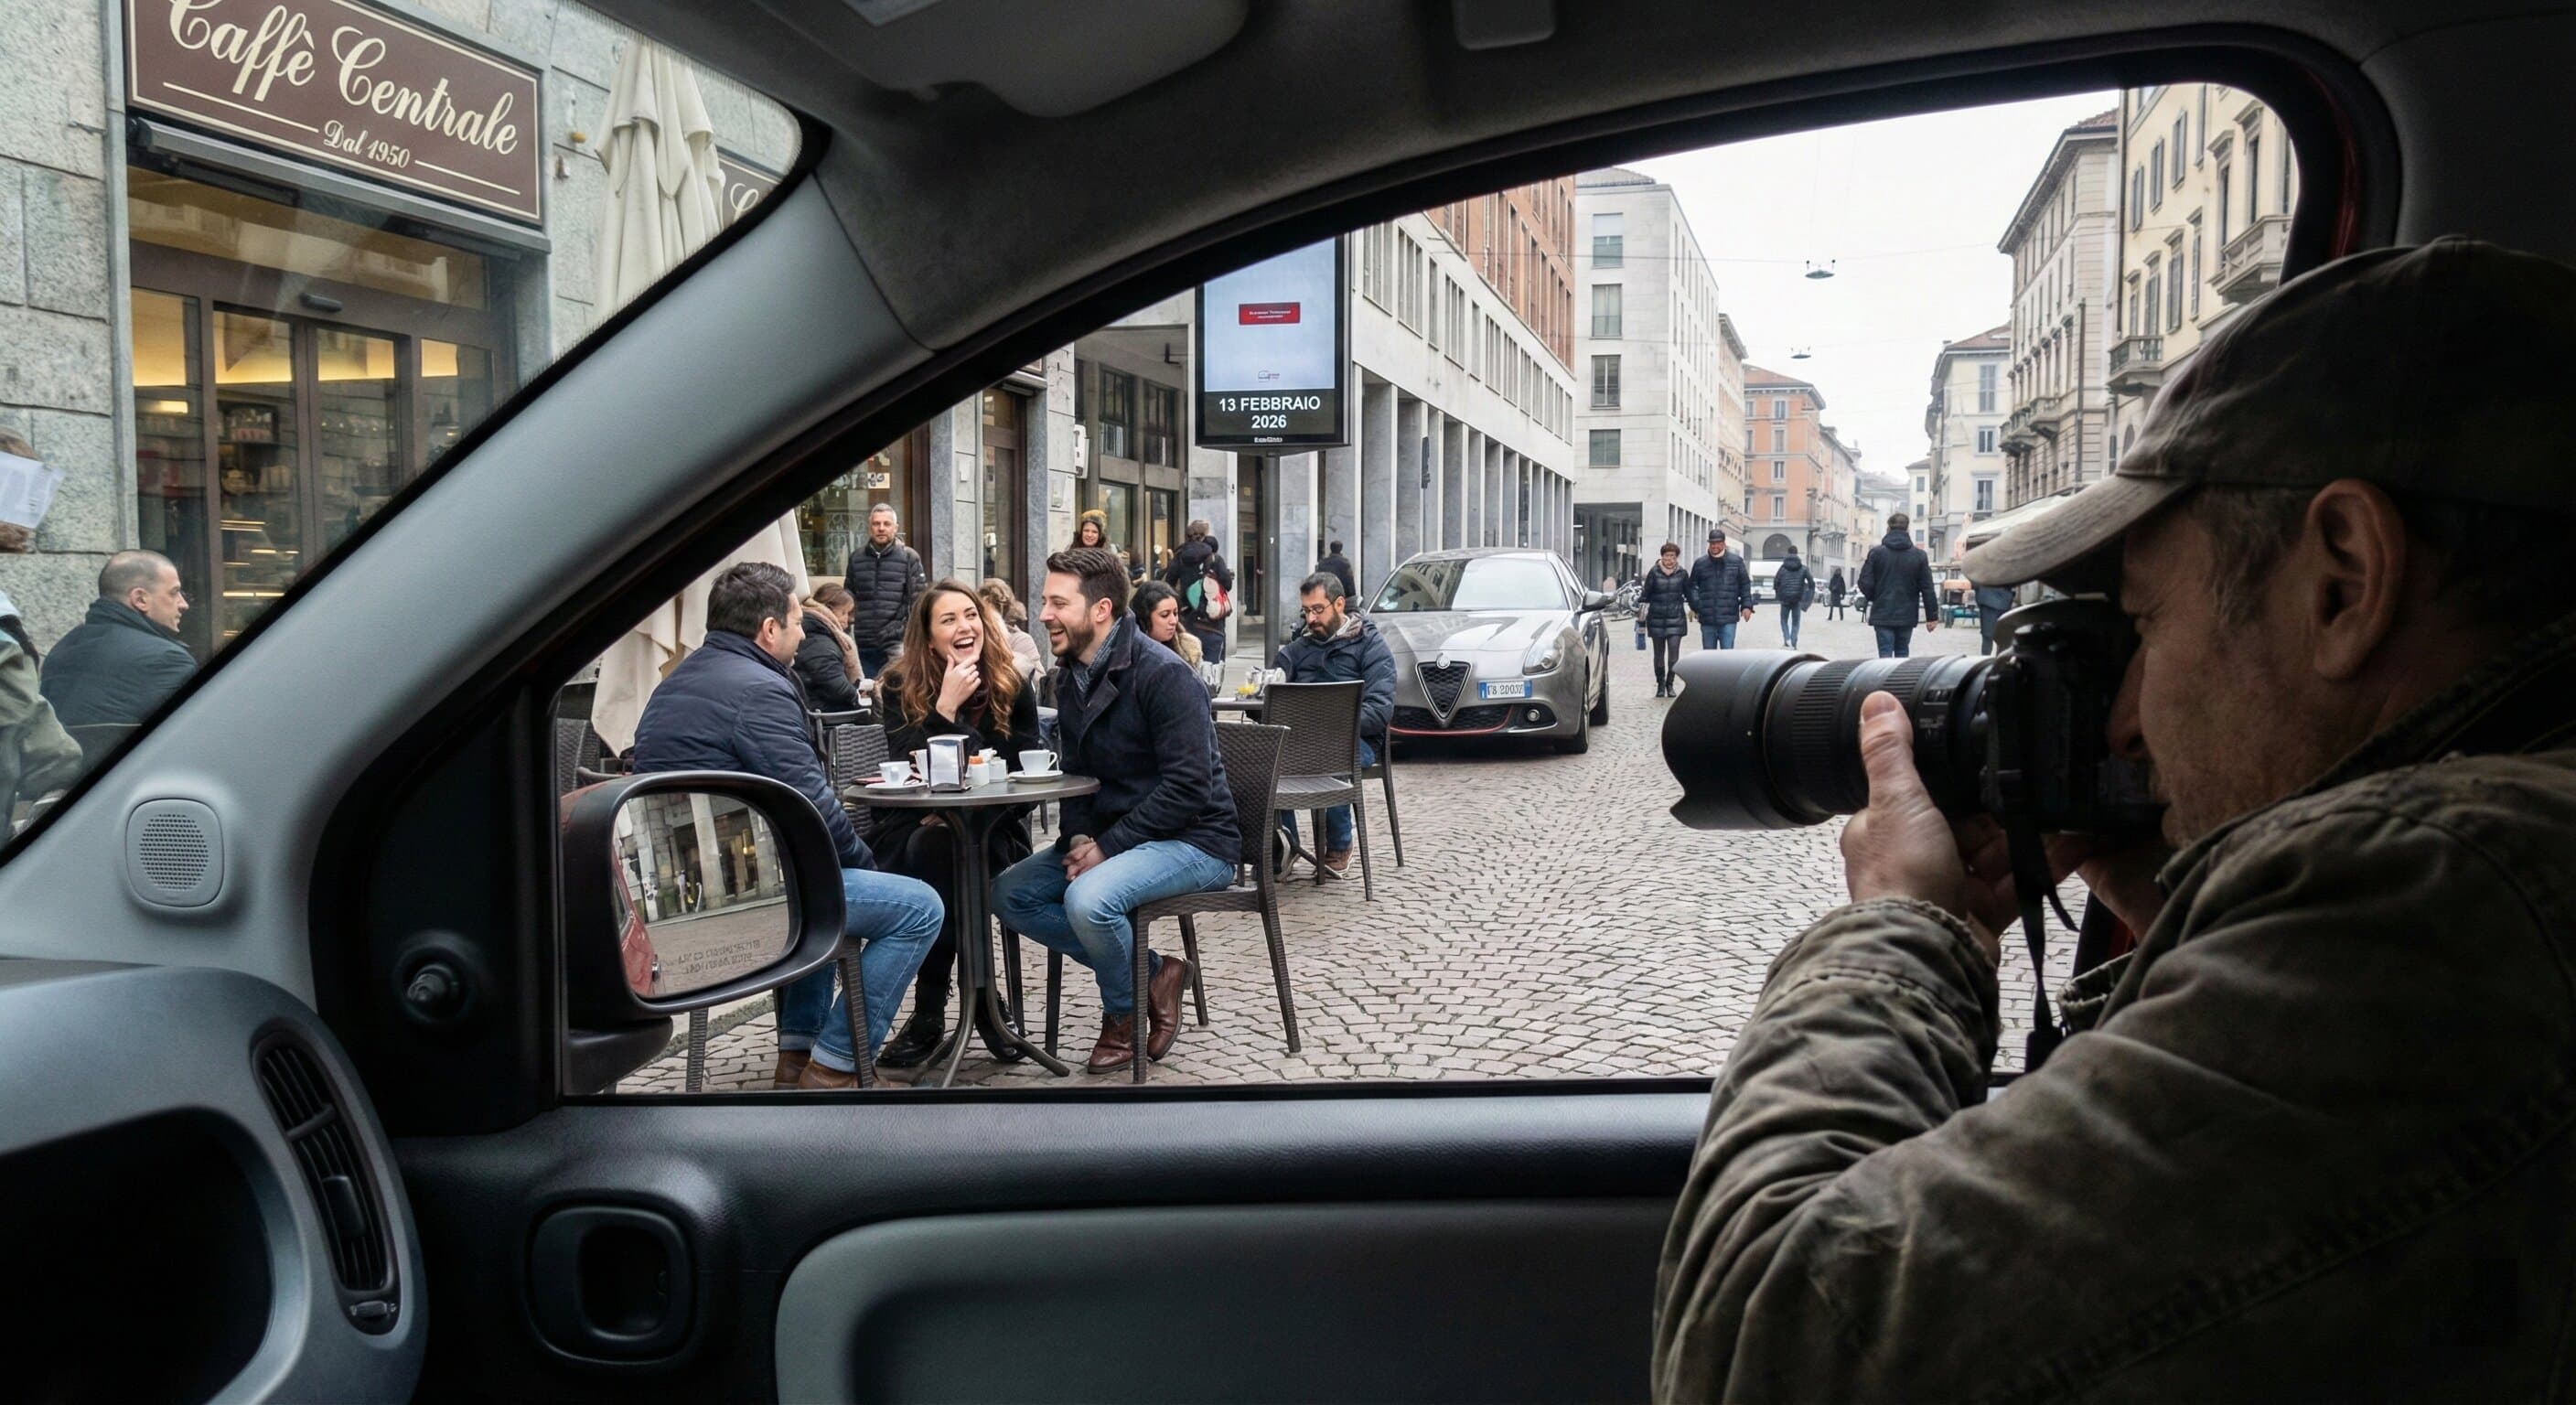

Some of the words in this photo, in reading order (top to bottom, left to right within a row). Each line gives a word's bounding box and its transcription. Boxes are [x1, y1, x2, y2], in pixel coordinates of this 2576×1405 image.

[169, 0, 316, 102] Caffè
[331, 26, 518, 155] Centrale
[323, 120, 368, 155] Dal
[368, 139, 411, 168] 1950
[1219, 398, 1236, 412] 13
[1240, 395, 1321, 412] FEBBRAIO
[1251, 414, 1287, 429] 2026
